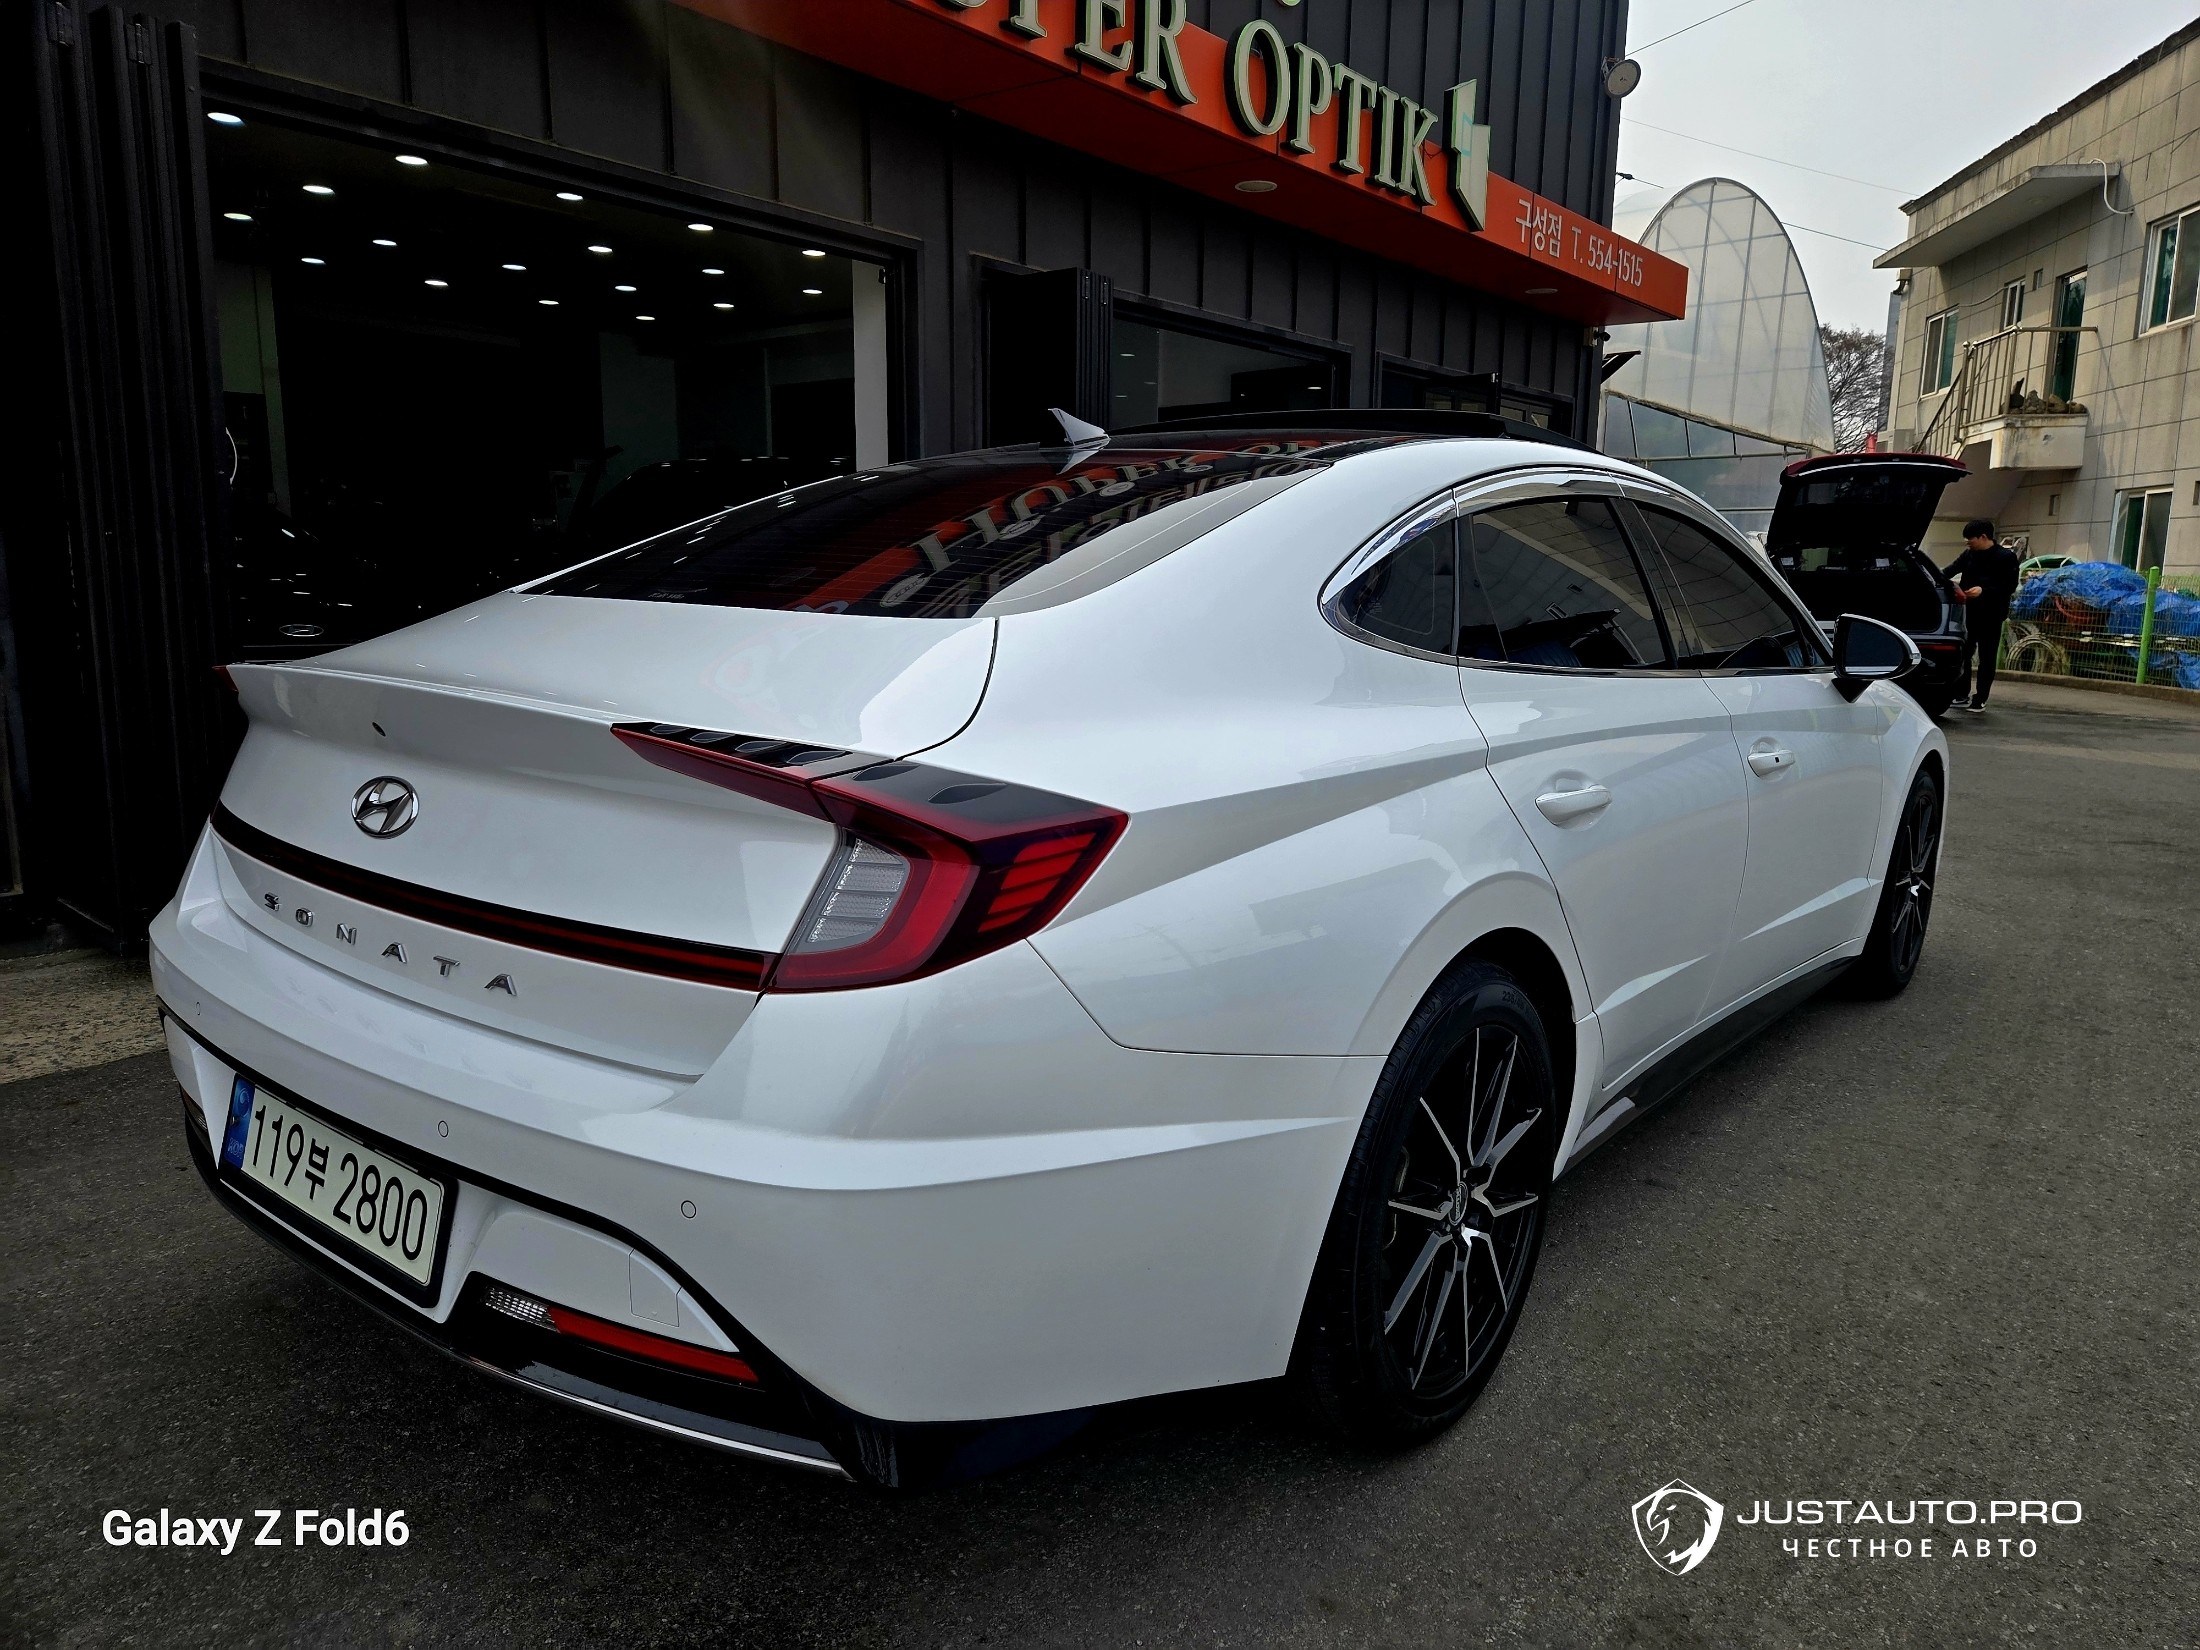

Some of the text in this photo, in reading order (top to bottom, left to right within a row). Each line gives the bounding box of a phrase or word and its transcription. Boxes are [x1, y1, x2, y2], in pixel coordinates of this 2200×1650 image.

[1226, 19, 1438, 206] OPTIK
[1515, 199, 1643, 287] 구성점 T. 554-1515
[264, 892, 517, 997] SONATA
[252, 1105, 428, 1261] 119부 2800
